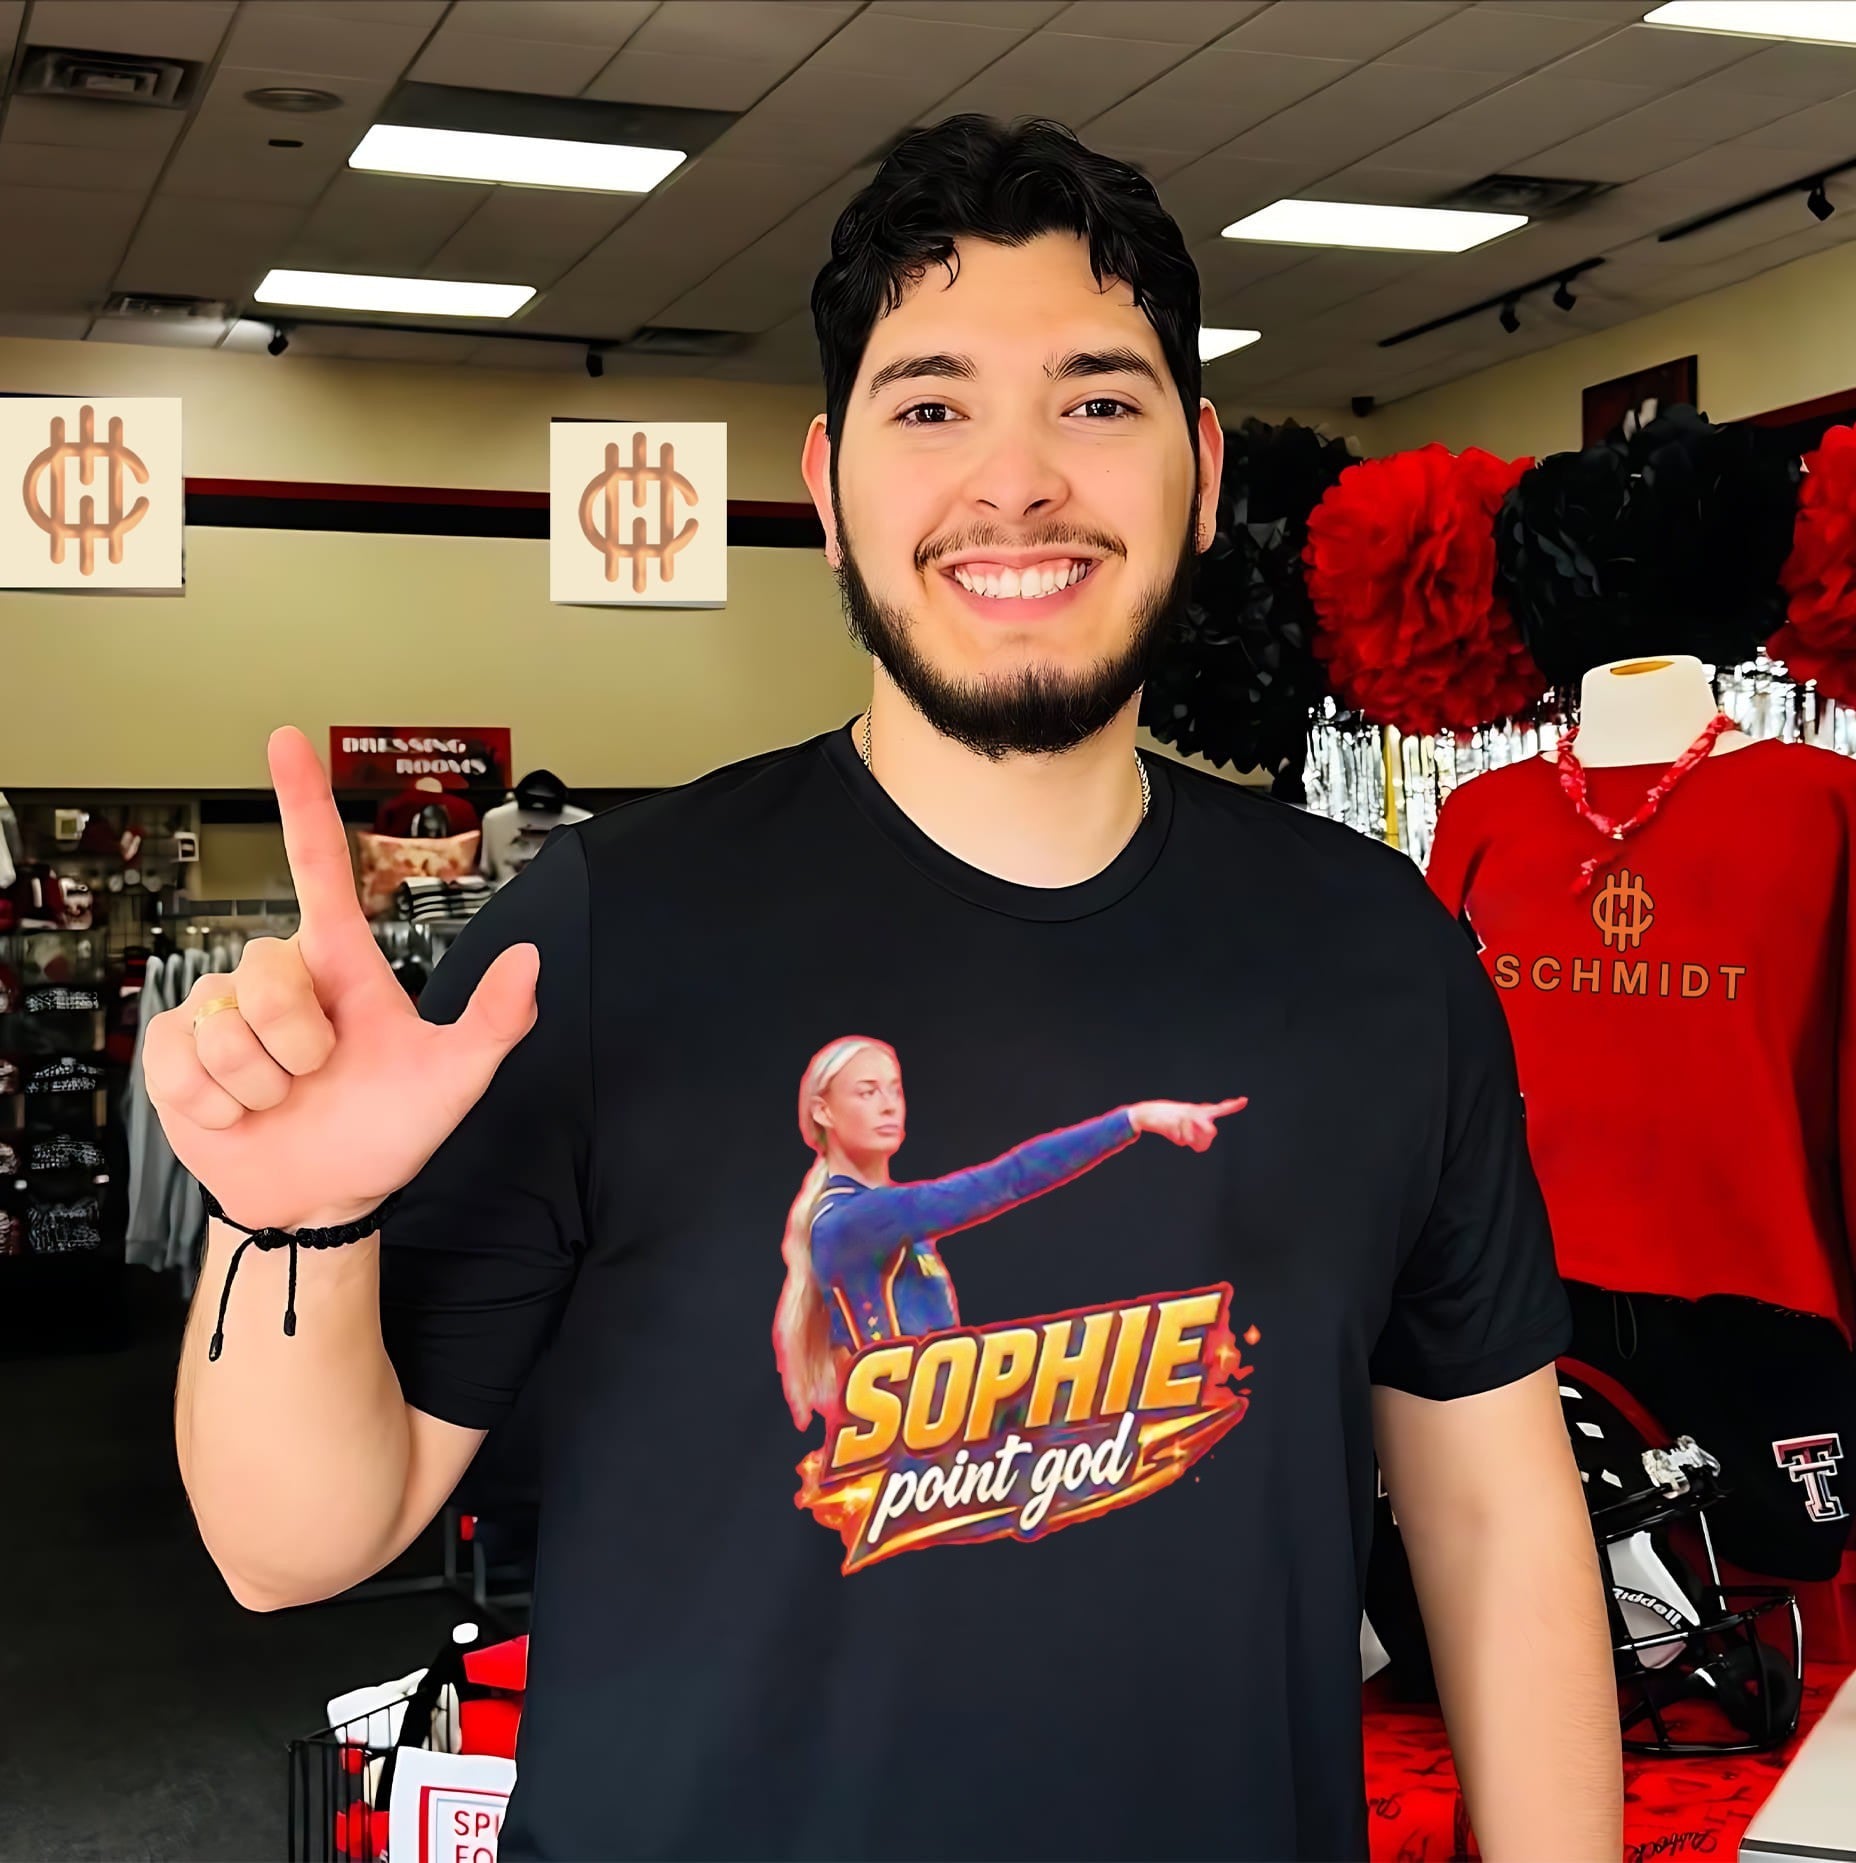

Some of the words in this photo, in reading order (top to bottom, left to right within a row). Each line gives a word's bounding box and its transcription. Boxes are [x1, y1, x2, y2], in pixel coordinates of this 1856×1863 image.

[342, 737, 467, 753] DRESSING
[396, 758, 487, 775] ROOMS
[1494, 954, 1747, 1000] SCHMIDT
[831, 1291, 1223, 1468] SOPHIE
[867, 1434, 1032, 1544] point
[1019, 1411, 1134, 1532] god
